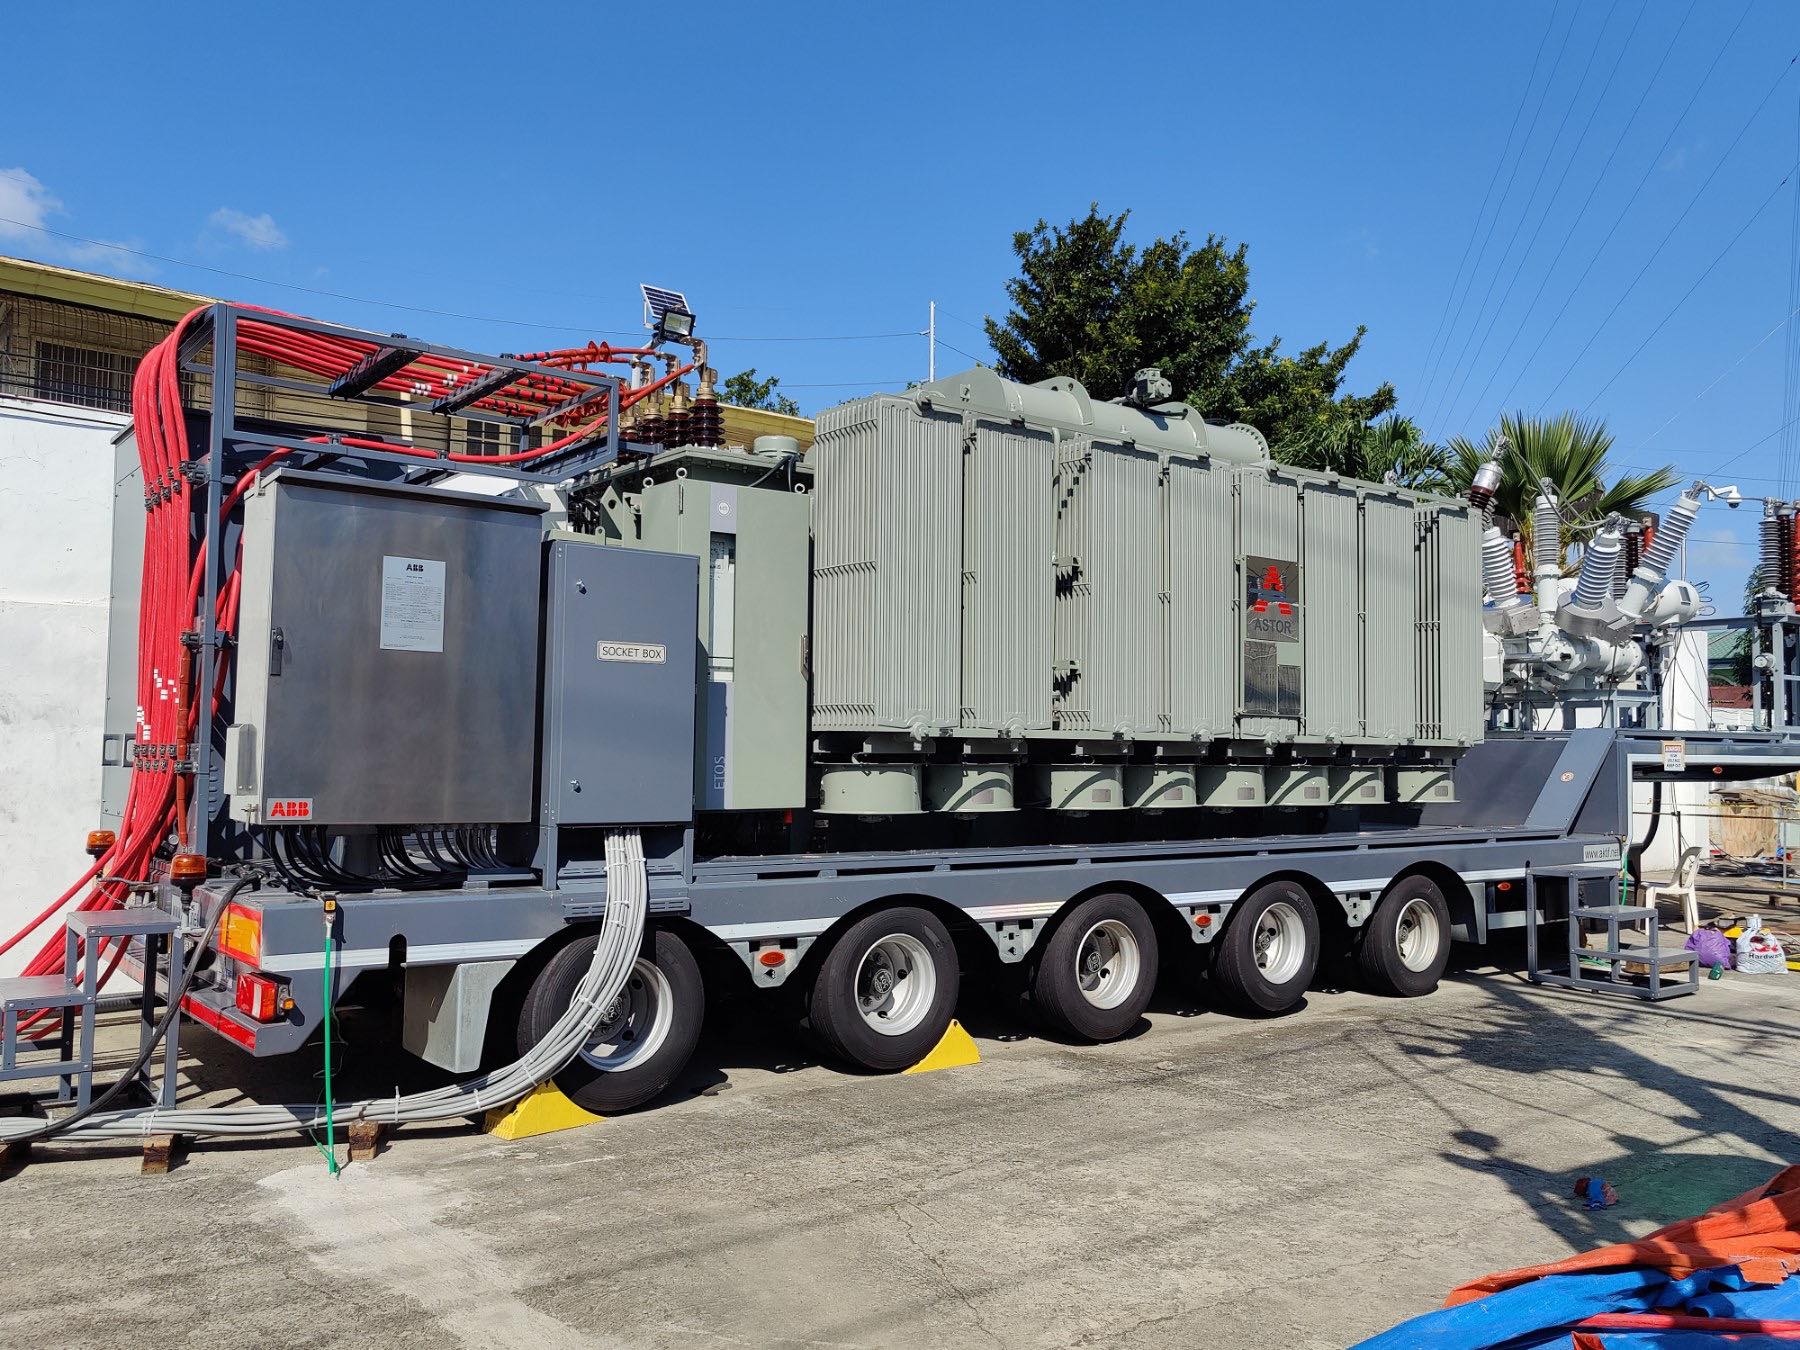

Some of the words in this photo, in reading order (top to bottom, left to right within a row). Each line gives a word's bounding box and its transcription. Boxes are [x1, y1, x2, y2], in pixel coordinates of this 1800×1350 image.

[406, 563, 424, 572] ABB
[1255, 619, 1292, 634] ASTOR
[602, 646, 640, 657] SOCKET
[642, 648, 662, 659] BOX
[713, 755, 725, 790] ETOS
[271, 801, 310, 817] ABB
